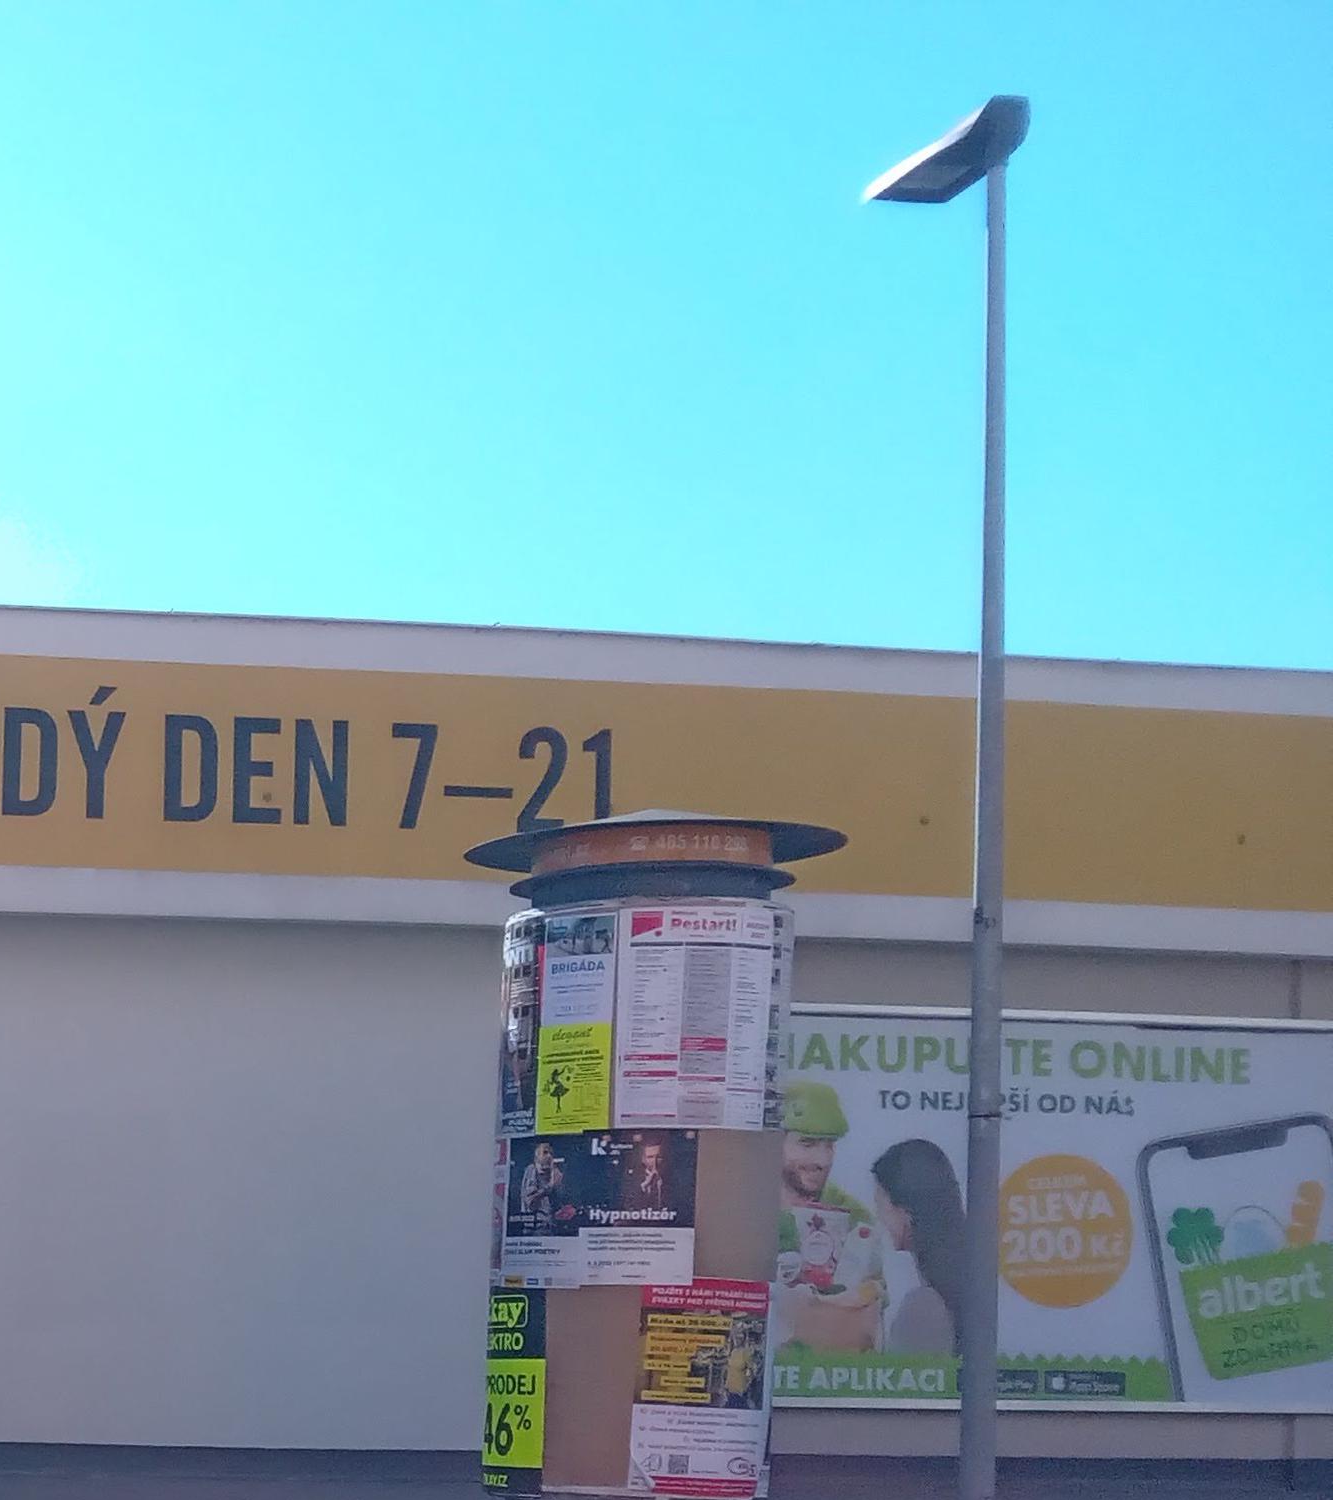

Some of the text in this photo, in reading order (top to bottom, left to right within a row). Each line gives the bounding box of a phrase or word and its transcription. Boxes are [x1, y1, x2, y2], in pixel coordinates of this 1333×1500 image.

[163, 714, 350, 828] DEN
[551, 959, 606, 976] BRIGÁDA
[787, 1032, 1251, 1085] AKUPUTE ONLINE
[878, 1086, 1136, 1117] TO NEJŠÍ OD NÁS
[589, 1206, 677, 1224] Hypnotizér
[1007, 1189, 1117, 1224] SLEVA
[1002, 1227, 1082, 1264] 200
[1199, 1261, 1326, 1319] albert
[488, 1331, 524, 1351] KTRO
[809, 1366, 945, 1393] APLIKACI
